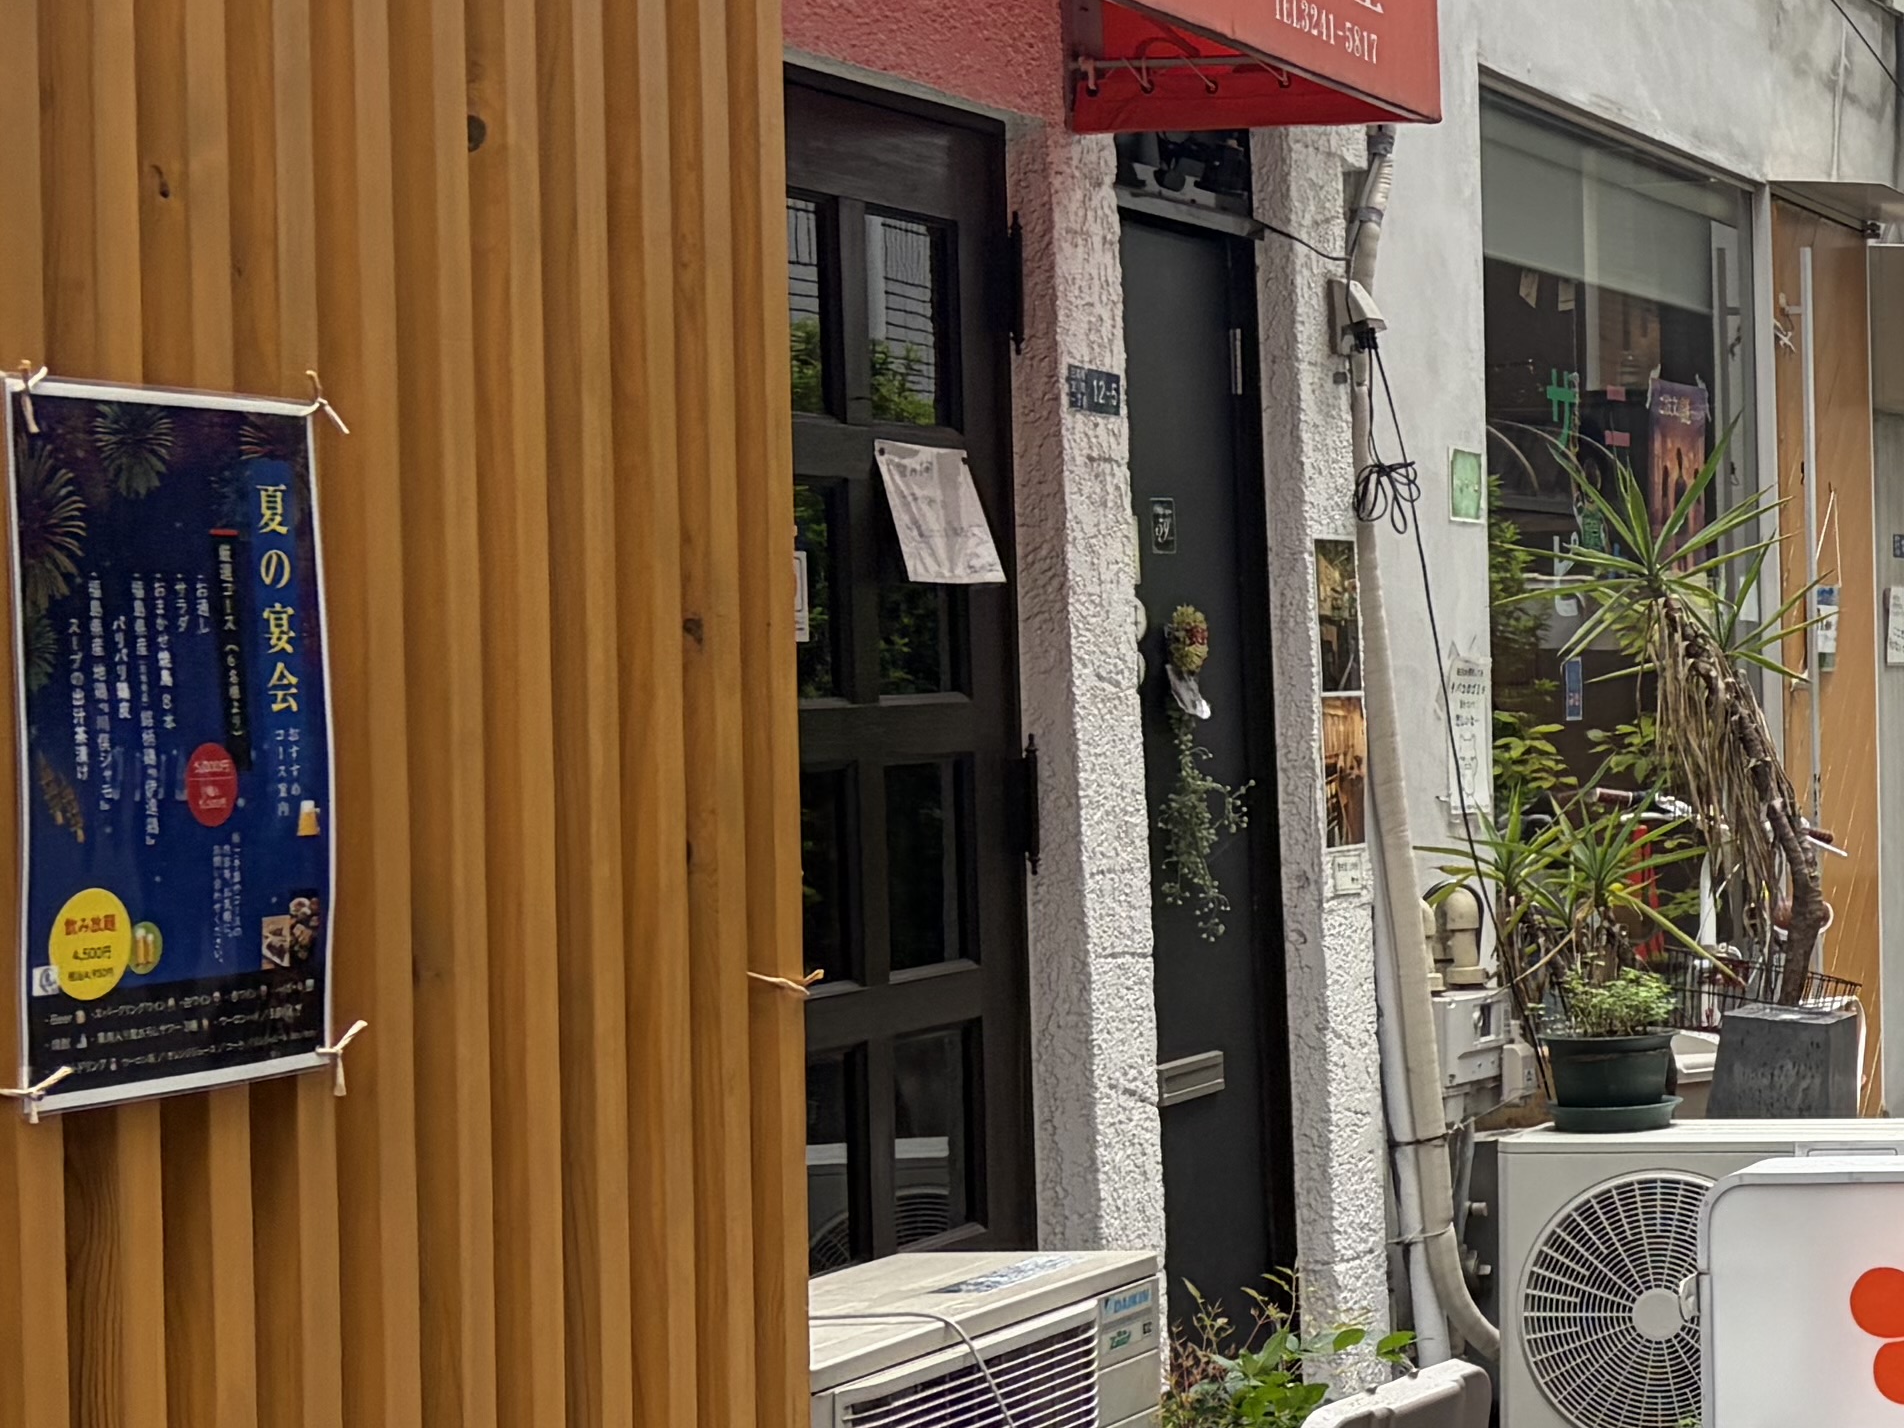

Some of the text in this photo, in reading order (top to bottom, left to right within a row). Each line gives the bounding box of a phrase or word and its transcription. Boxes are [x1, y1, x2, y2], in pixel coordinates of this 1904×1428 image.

[255, 483, 299, 714] 夏の宴会
[64, 914, 117, 936] 飲み放題
[72, 945, 112, 961] 4,500円
